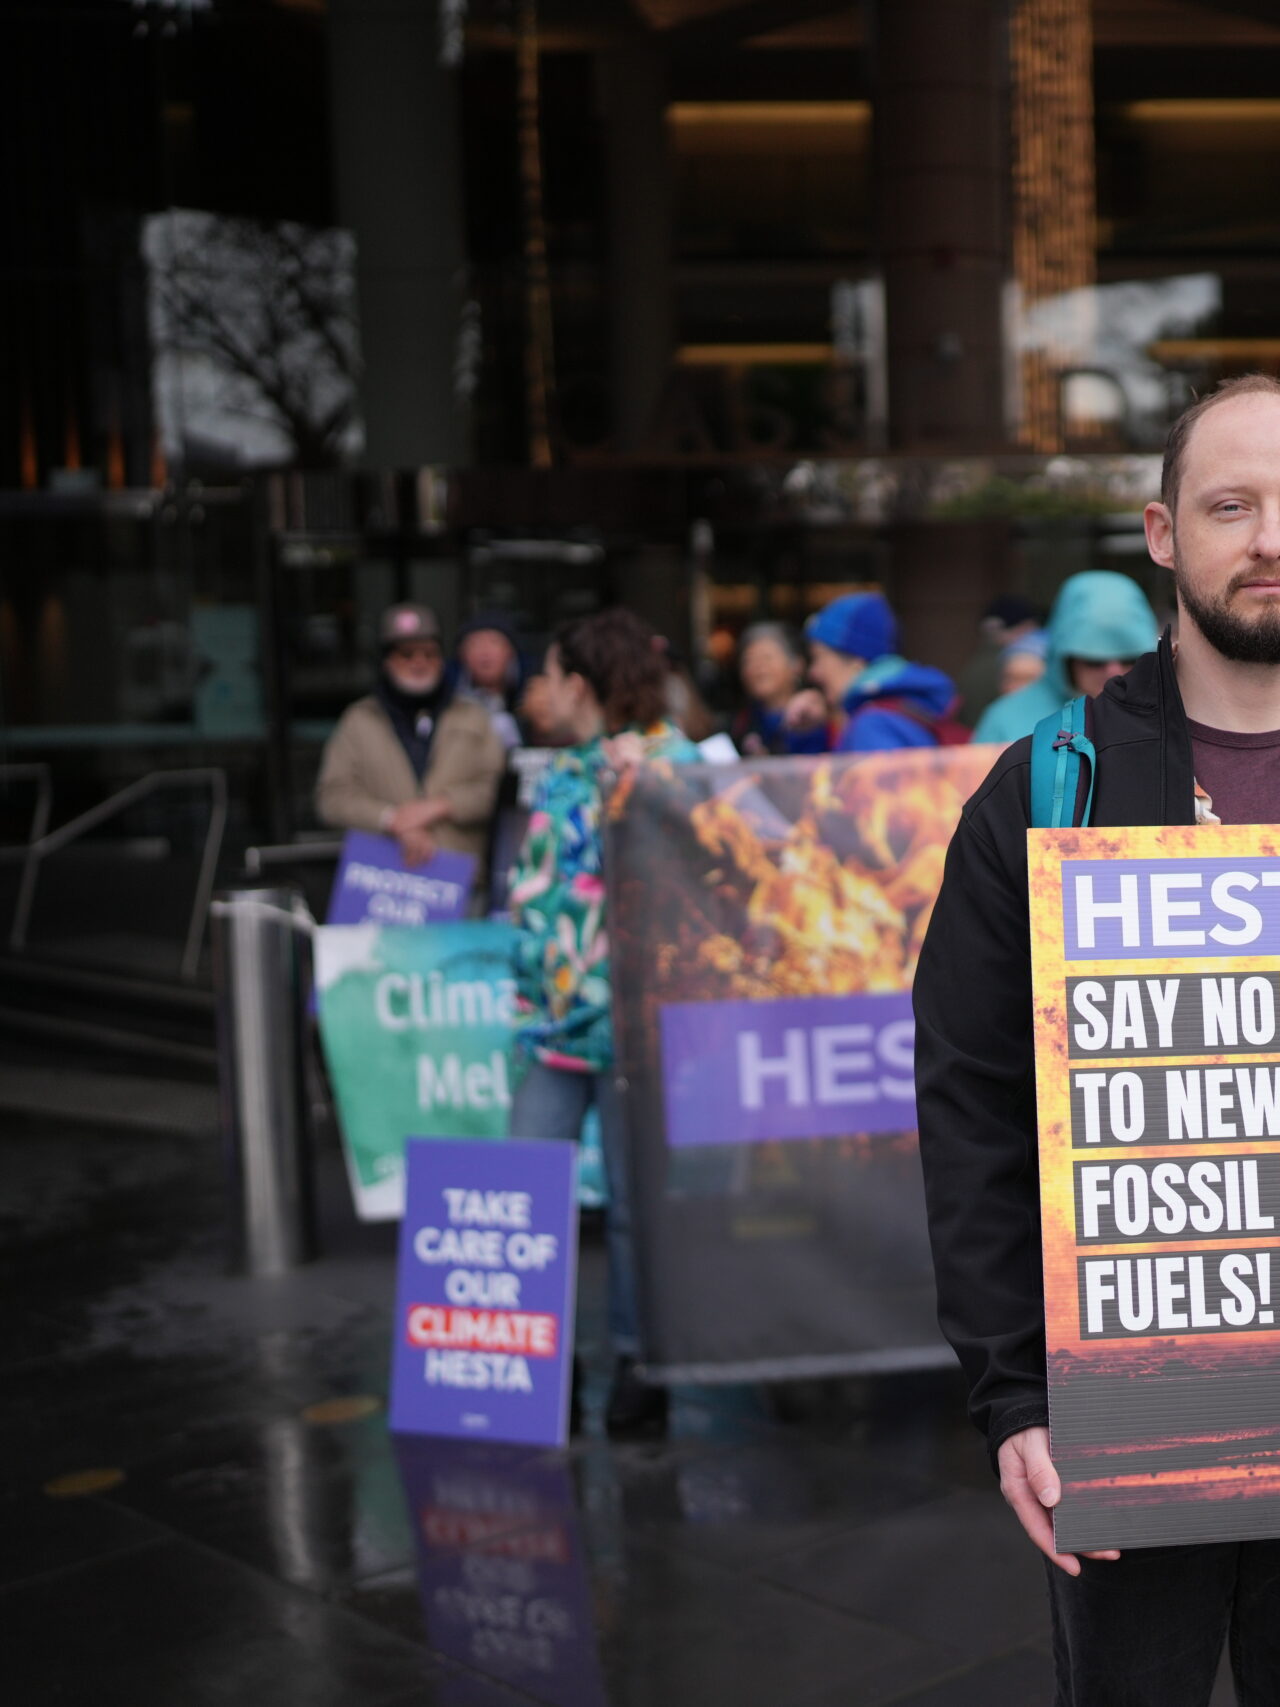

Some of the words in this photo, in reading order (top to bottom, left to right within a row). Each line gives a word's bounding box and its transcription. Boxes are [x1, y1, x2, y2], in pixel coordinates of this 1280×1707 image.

[344, 862, 464, 911] PROTECT
[1072, 979, 1180, 1051] SAY
[1201, 977, 1276, 1047] NO
[417, 1050, 512, 1112] Mel
[738, 1019, 916, 1111] HES
[1075, 1071, 1145, 1143] TO
[443, 1188, 532, 1229] TAKE
[1081, 1160, 1274, 1237] FOSSIL
[413, 1227, 505, 1268] CARE
[505, 1233, 558, 1271] OF
[445, 1269, 520, 1308] OUR
[1085, 1253, 1274, 1333] FUELS!
[408, 1307, 556, 1355] CLIMATE
[425, 1349, 533, 1392] HESTA
